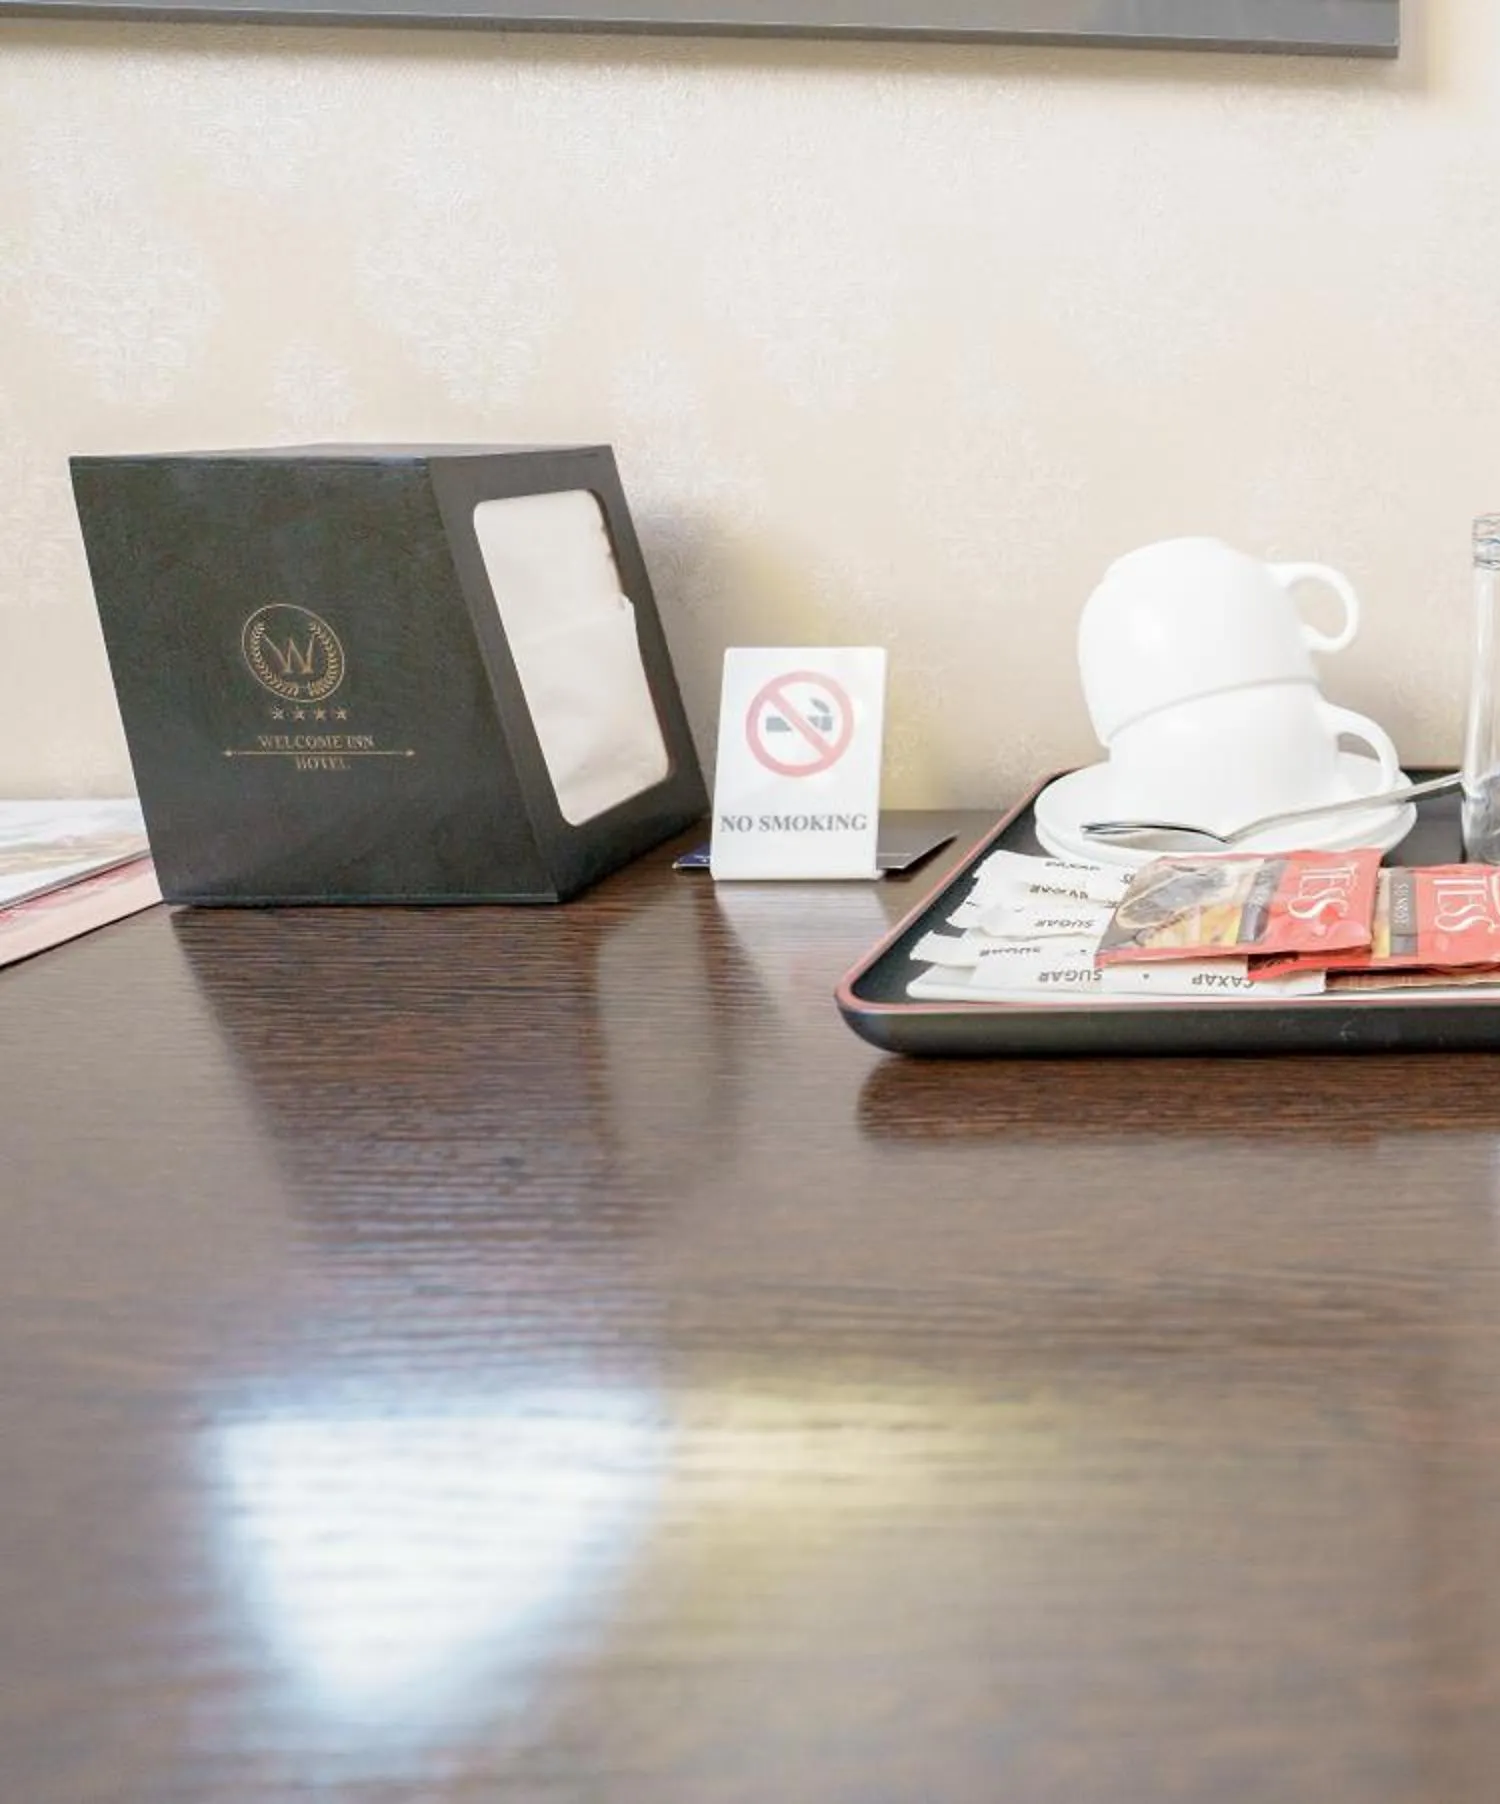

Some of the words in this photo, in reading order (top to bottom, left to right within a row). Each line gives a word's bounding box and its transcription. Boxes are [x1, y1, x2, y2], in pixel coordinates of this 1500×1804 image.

[262, 633, 316, 675] W
[258, 735, 343, 749] WELCOME
[346, 735, 374, 749] INN
[295, 756, 351, 770] HOTEL
[720, 815, 753, 833] NO
[758, 813, 868, 833] SMOKING
[1286, 861, 1358, 919] TESS
[1038, 968, 1104, 983] SUGAR
